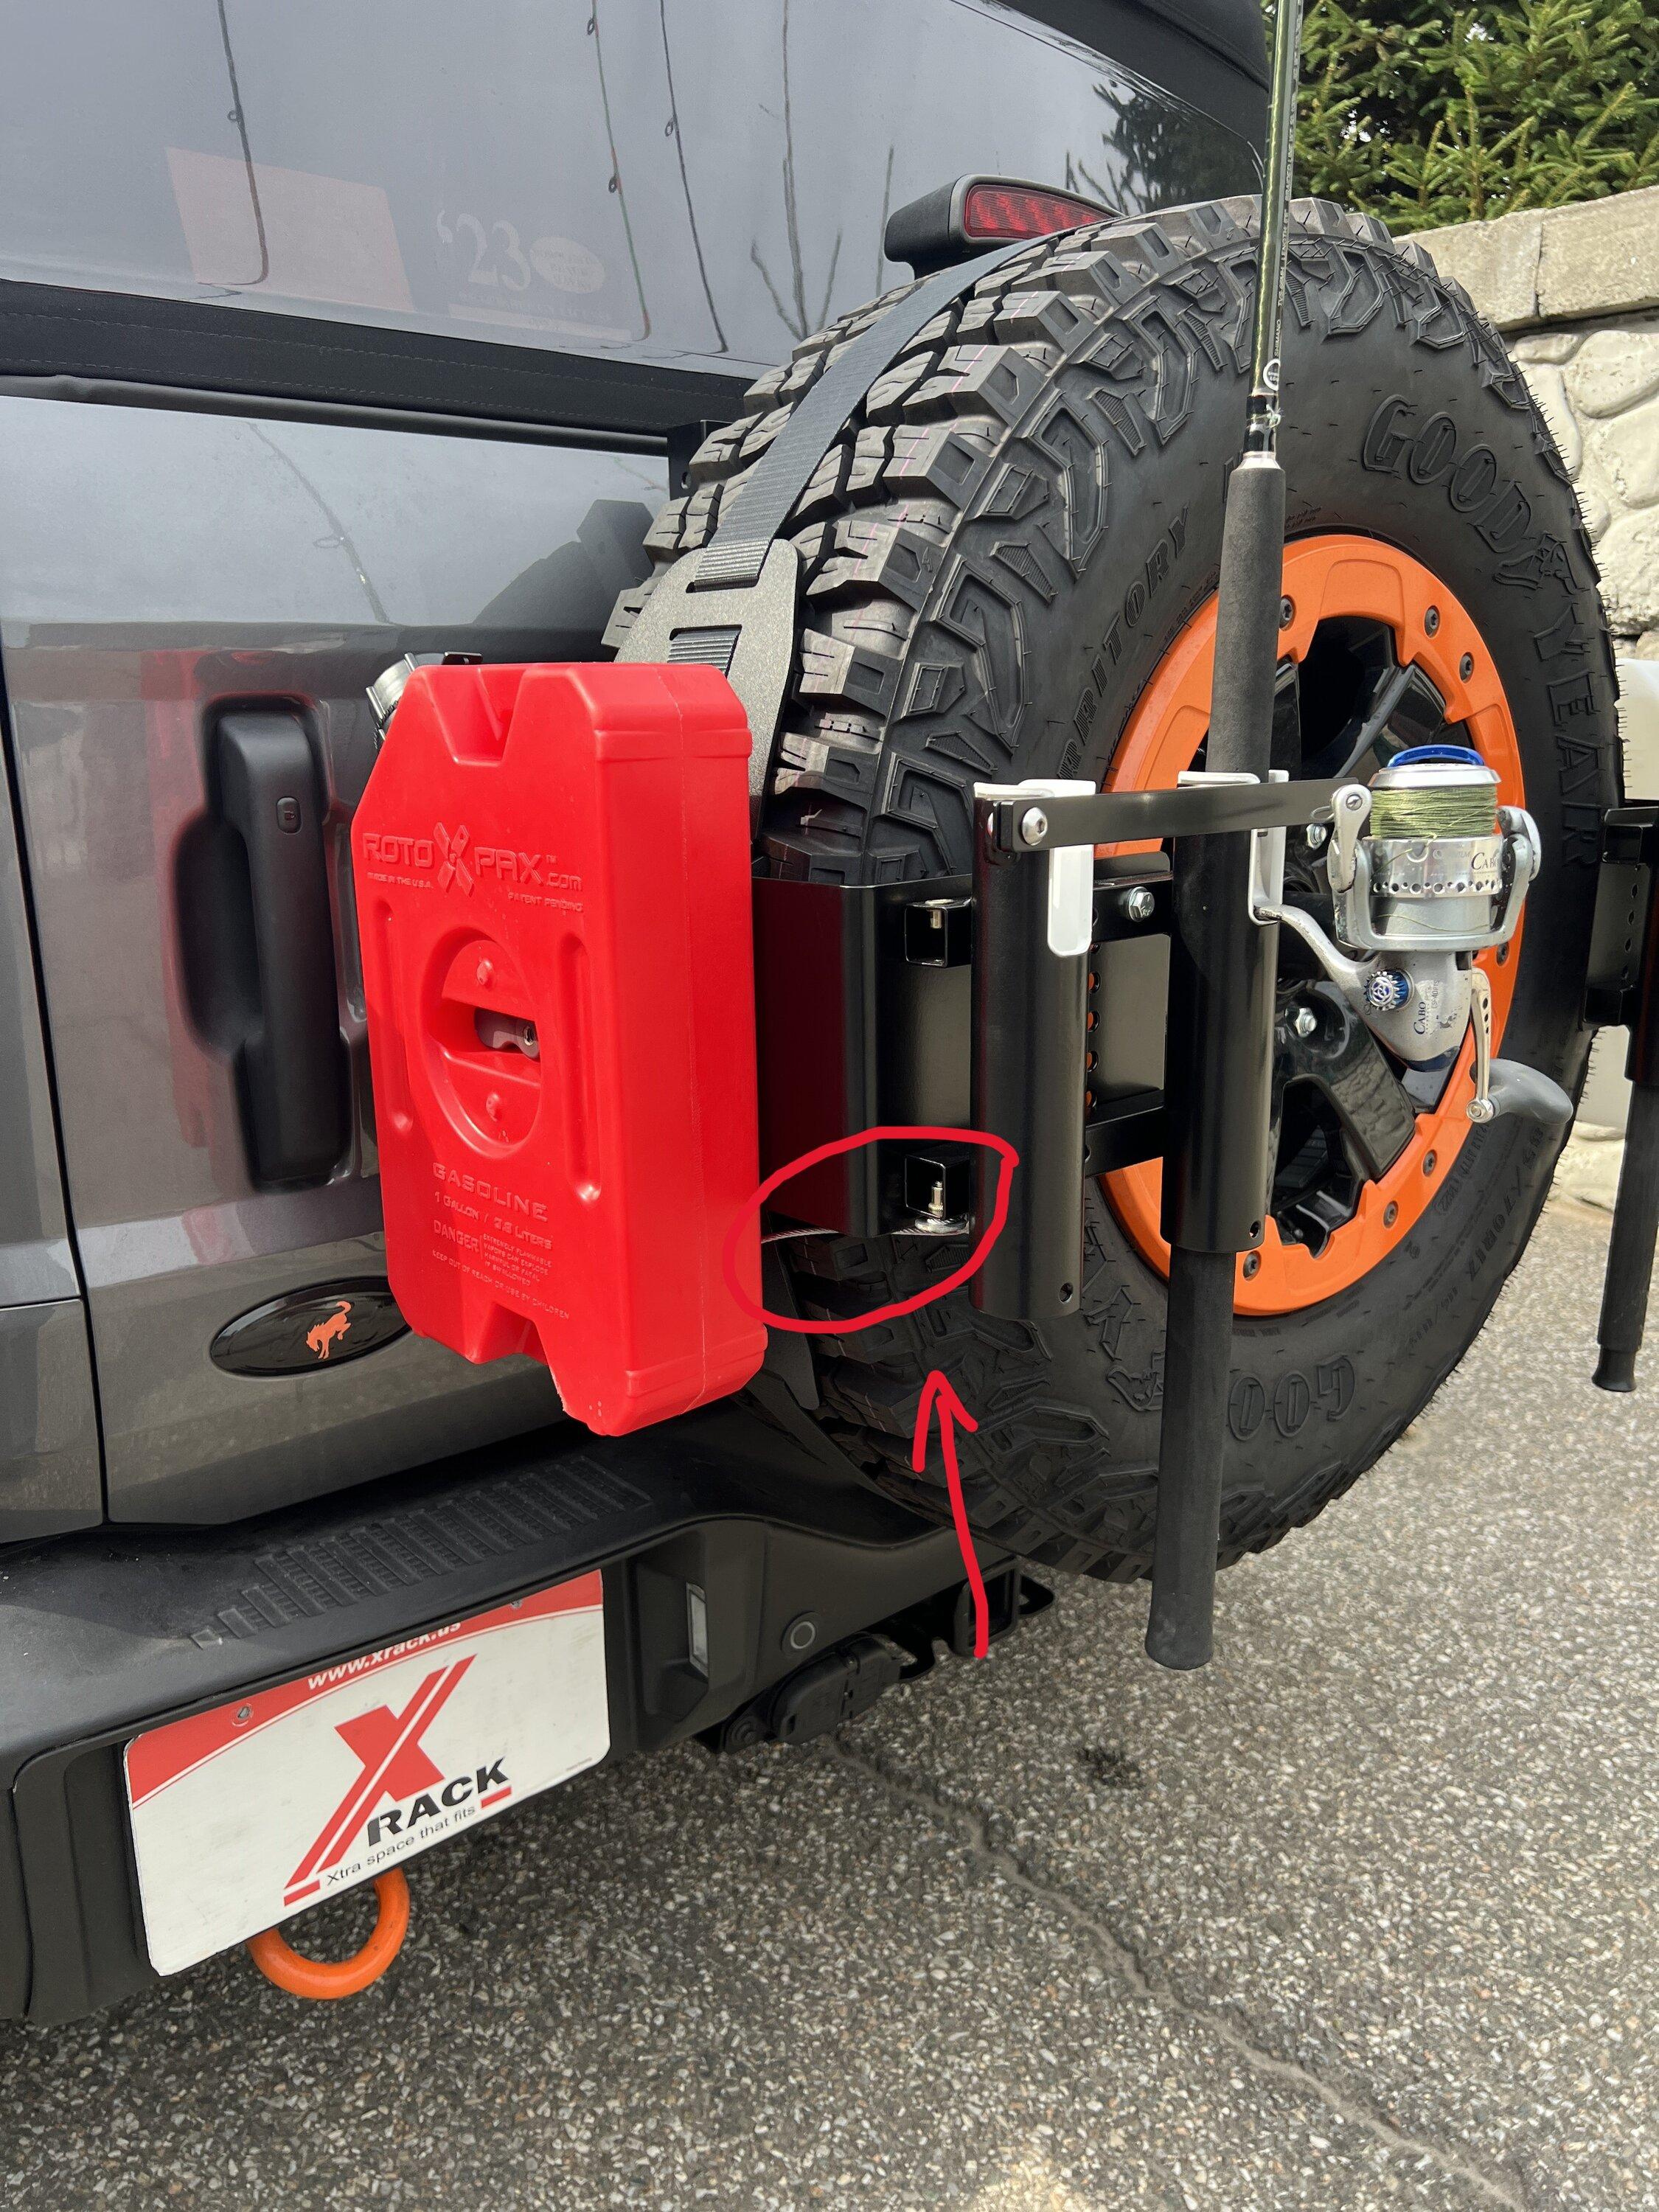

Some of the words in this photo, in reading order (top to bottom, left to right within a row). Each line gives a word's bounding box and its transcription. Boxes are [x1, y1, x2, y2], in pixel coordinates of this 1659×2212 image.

[1273, 318, 1282, 356] SHIMANO
[362, 832, 434, 868] ROTO
[474, 846, 544, 886] PAX
[366, 872, 387, 882] MADE
[397, 877, 411, 886] THE
[507, 891, 543, 905] PATENT
[544, 897, 583, 912] PENDING
[1413, 1001, 1426, 1035] CABO
[432, 1162, 548, 1222] GASOLINE
[433, 1220, 479, 1253] DANGER
[434, 1191, 440, 1203] 1
[443, 1194, 479, 1221] GALLON
[515, 1225, 552, 1251] LITERS
[431, 1249, 448, 1262] KEEP
[448, 1258, 461, 1270] OUT
[307, 1622, 462, 1690] www.xrack.us
[367, 1756, 509, 1847] RACK
[327, 1862, 361, 1886] Xtra
[366, 1836, 415, 1866] space
[420, 1815, 450, 1840] that
[453, 1805, 476, 1823] fits
